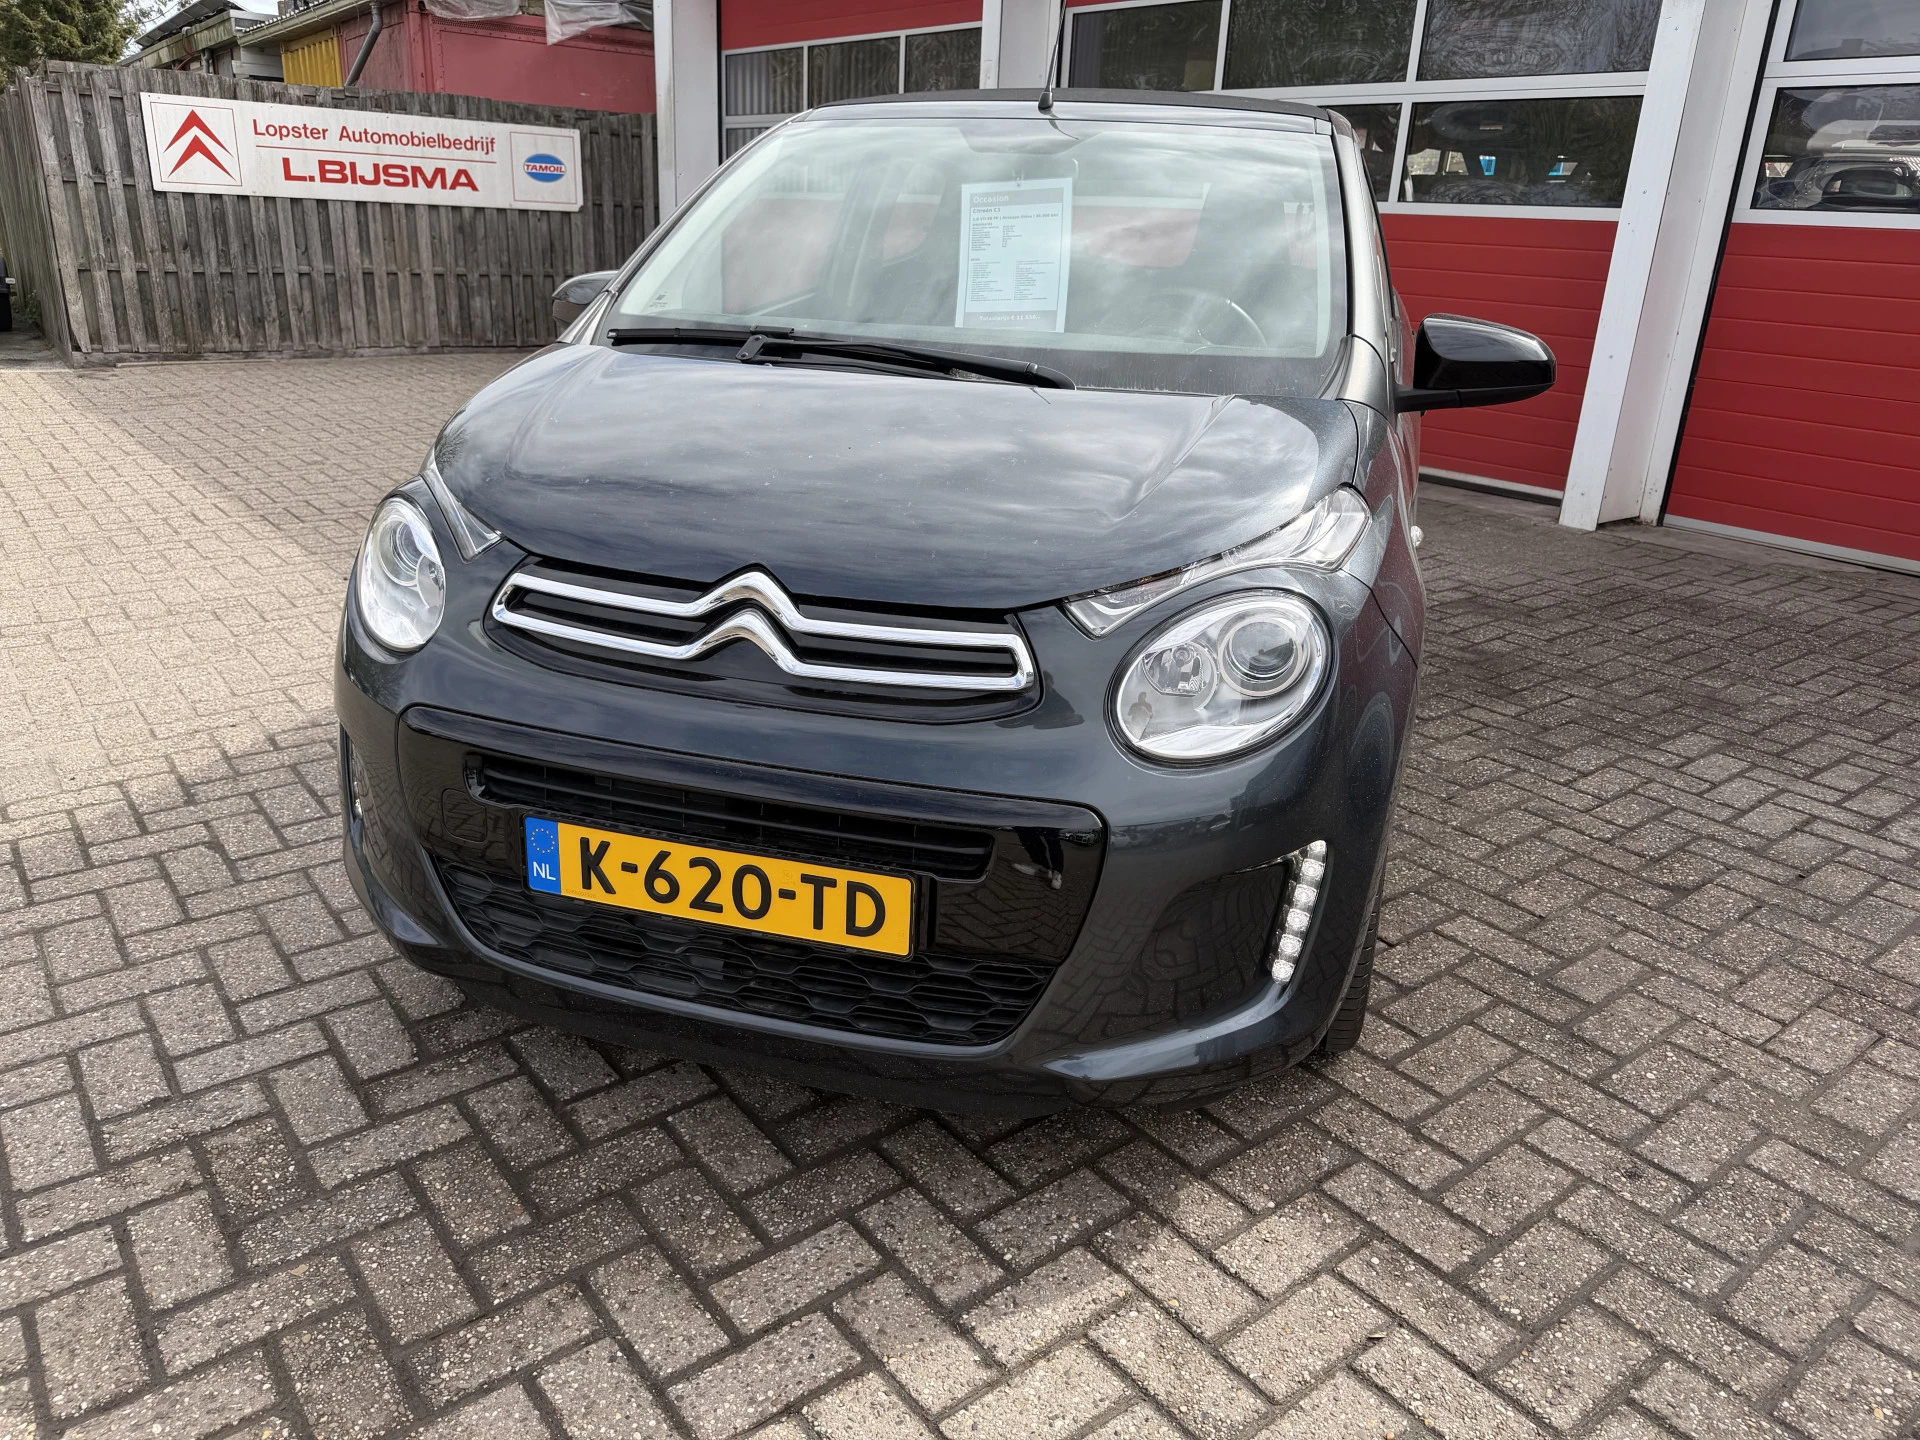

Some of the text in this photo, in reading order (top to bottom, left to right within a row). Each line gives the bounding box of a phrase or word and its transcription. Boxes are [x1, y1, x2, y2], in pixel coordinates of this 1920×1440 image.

[252, 118, 496, 154] Lopster Automobielbedrijf
[281, 156, 480, 192] L.BIJSMA
[525, 163, 565, 173] TAMOIL
[973, 195, 1009, 204] Occasion
[533, 861, 556, 882] NL
[579, 836, 887, 938] K-620-TD
